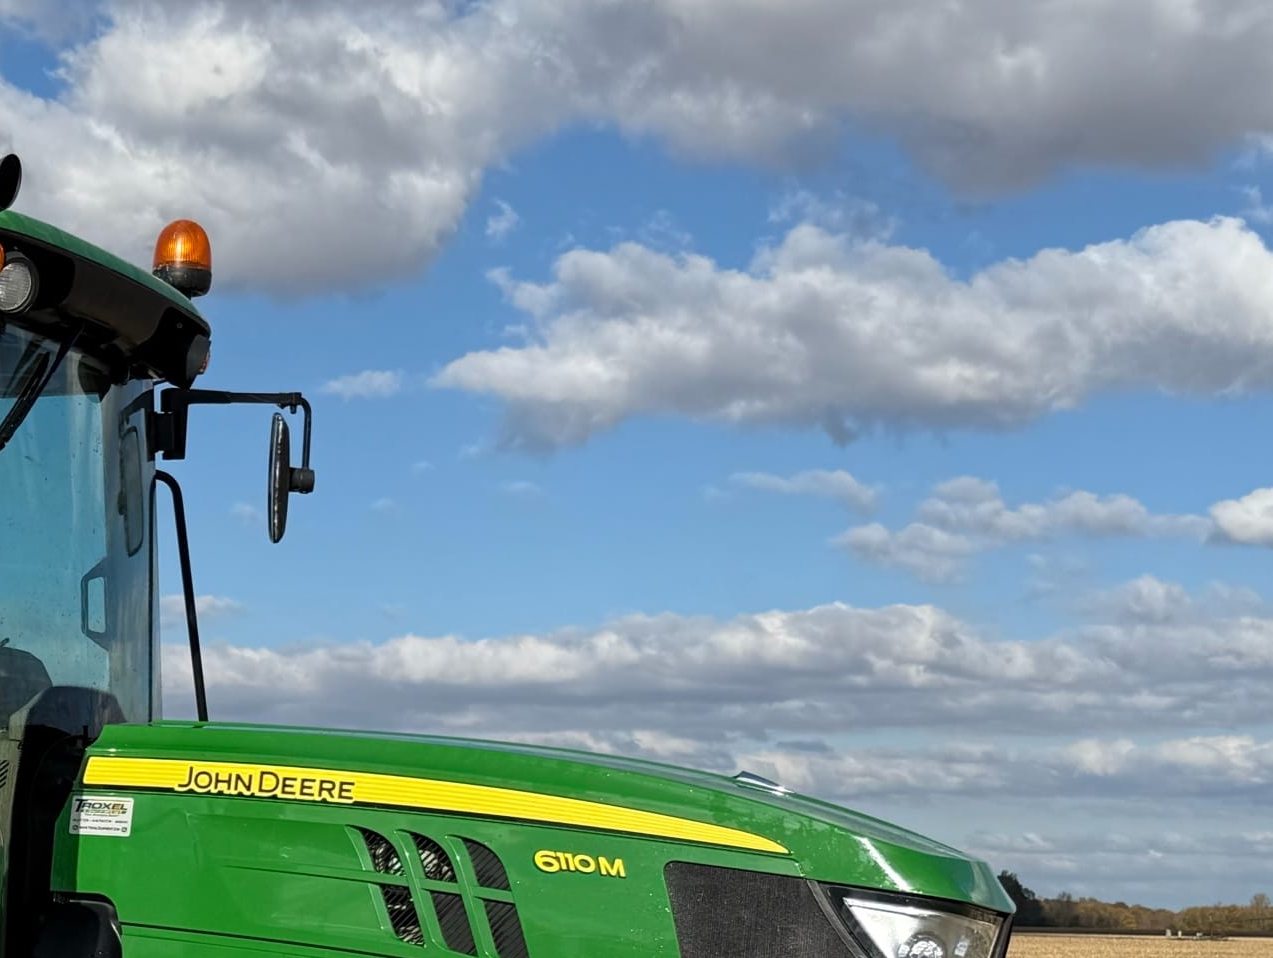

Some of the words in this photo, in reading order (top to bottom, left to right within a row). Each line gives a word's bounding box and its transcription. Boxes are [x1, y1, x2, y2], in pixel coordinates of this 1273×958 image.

[177, 766, 253, 792] JOHN
[258, 770, 355, 800] DEERE
[74, 798, 128, 812] TROXEL
